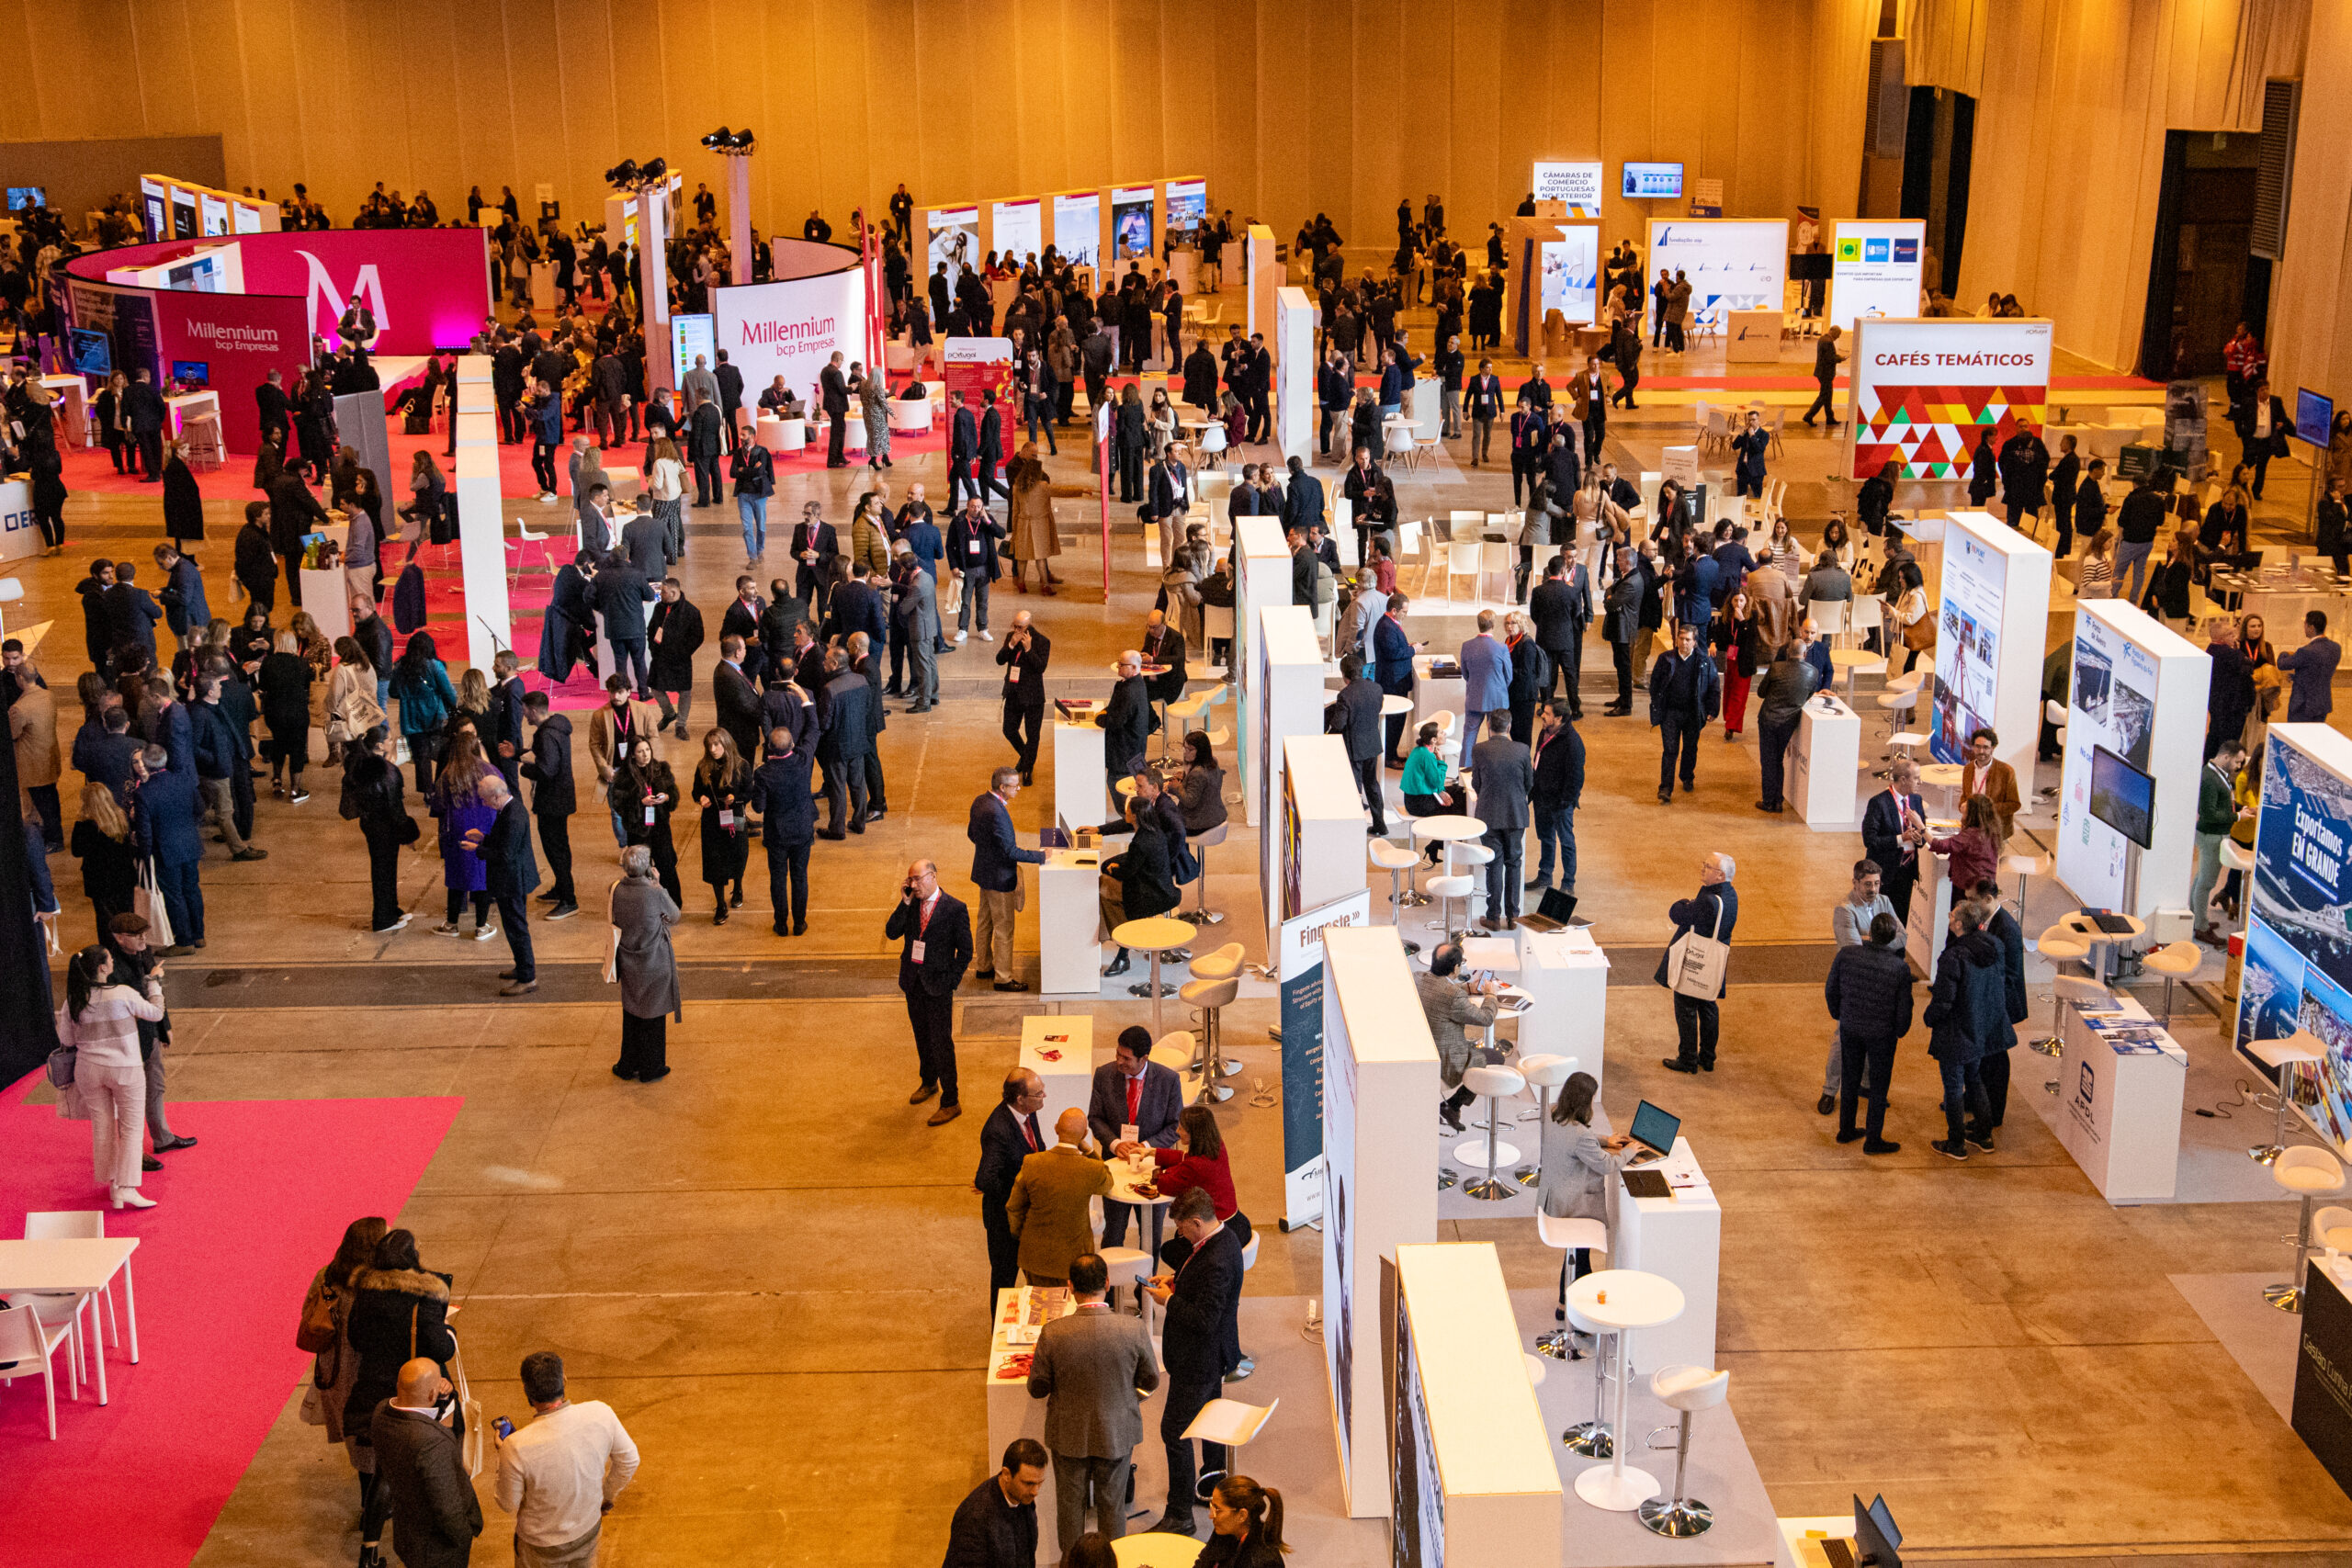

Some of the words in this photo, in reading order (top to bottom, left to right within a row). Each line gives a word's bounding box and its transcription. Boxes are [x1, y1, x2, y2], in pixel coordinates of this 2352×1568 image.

[187, 318, 278, 342] Millennium
[741, 316, 835, 346] Millennium
[215, 339, 233, 352] bcp
[235, 341, 280, 353] Empresas
[776, 344, 796, 358] bcp
[798, 337, 835, 355] Empresas
[1875, 350, 1931, 367] CAFÉS
[1936, 350, 2034, 367] TEMÁTICOS
[2295, 802, 2344, 858] Exportamos
[2291, 831, 2306, 862] EM
[2305, 842, 2341, 888] GRANDE
[1292, 991, 1312, 1005] Structure
[1312, 987, 1322, 996] with
[1305, 997, 1317, 1008] Equity
[2075, 1095, 2095, 1125] APDL
